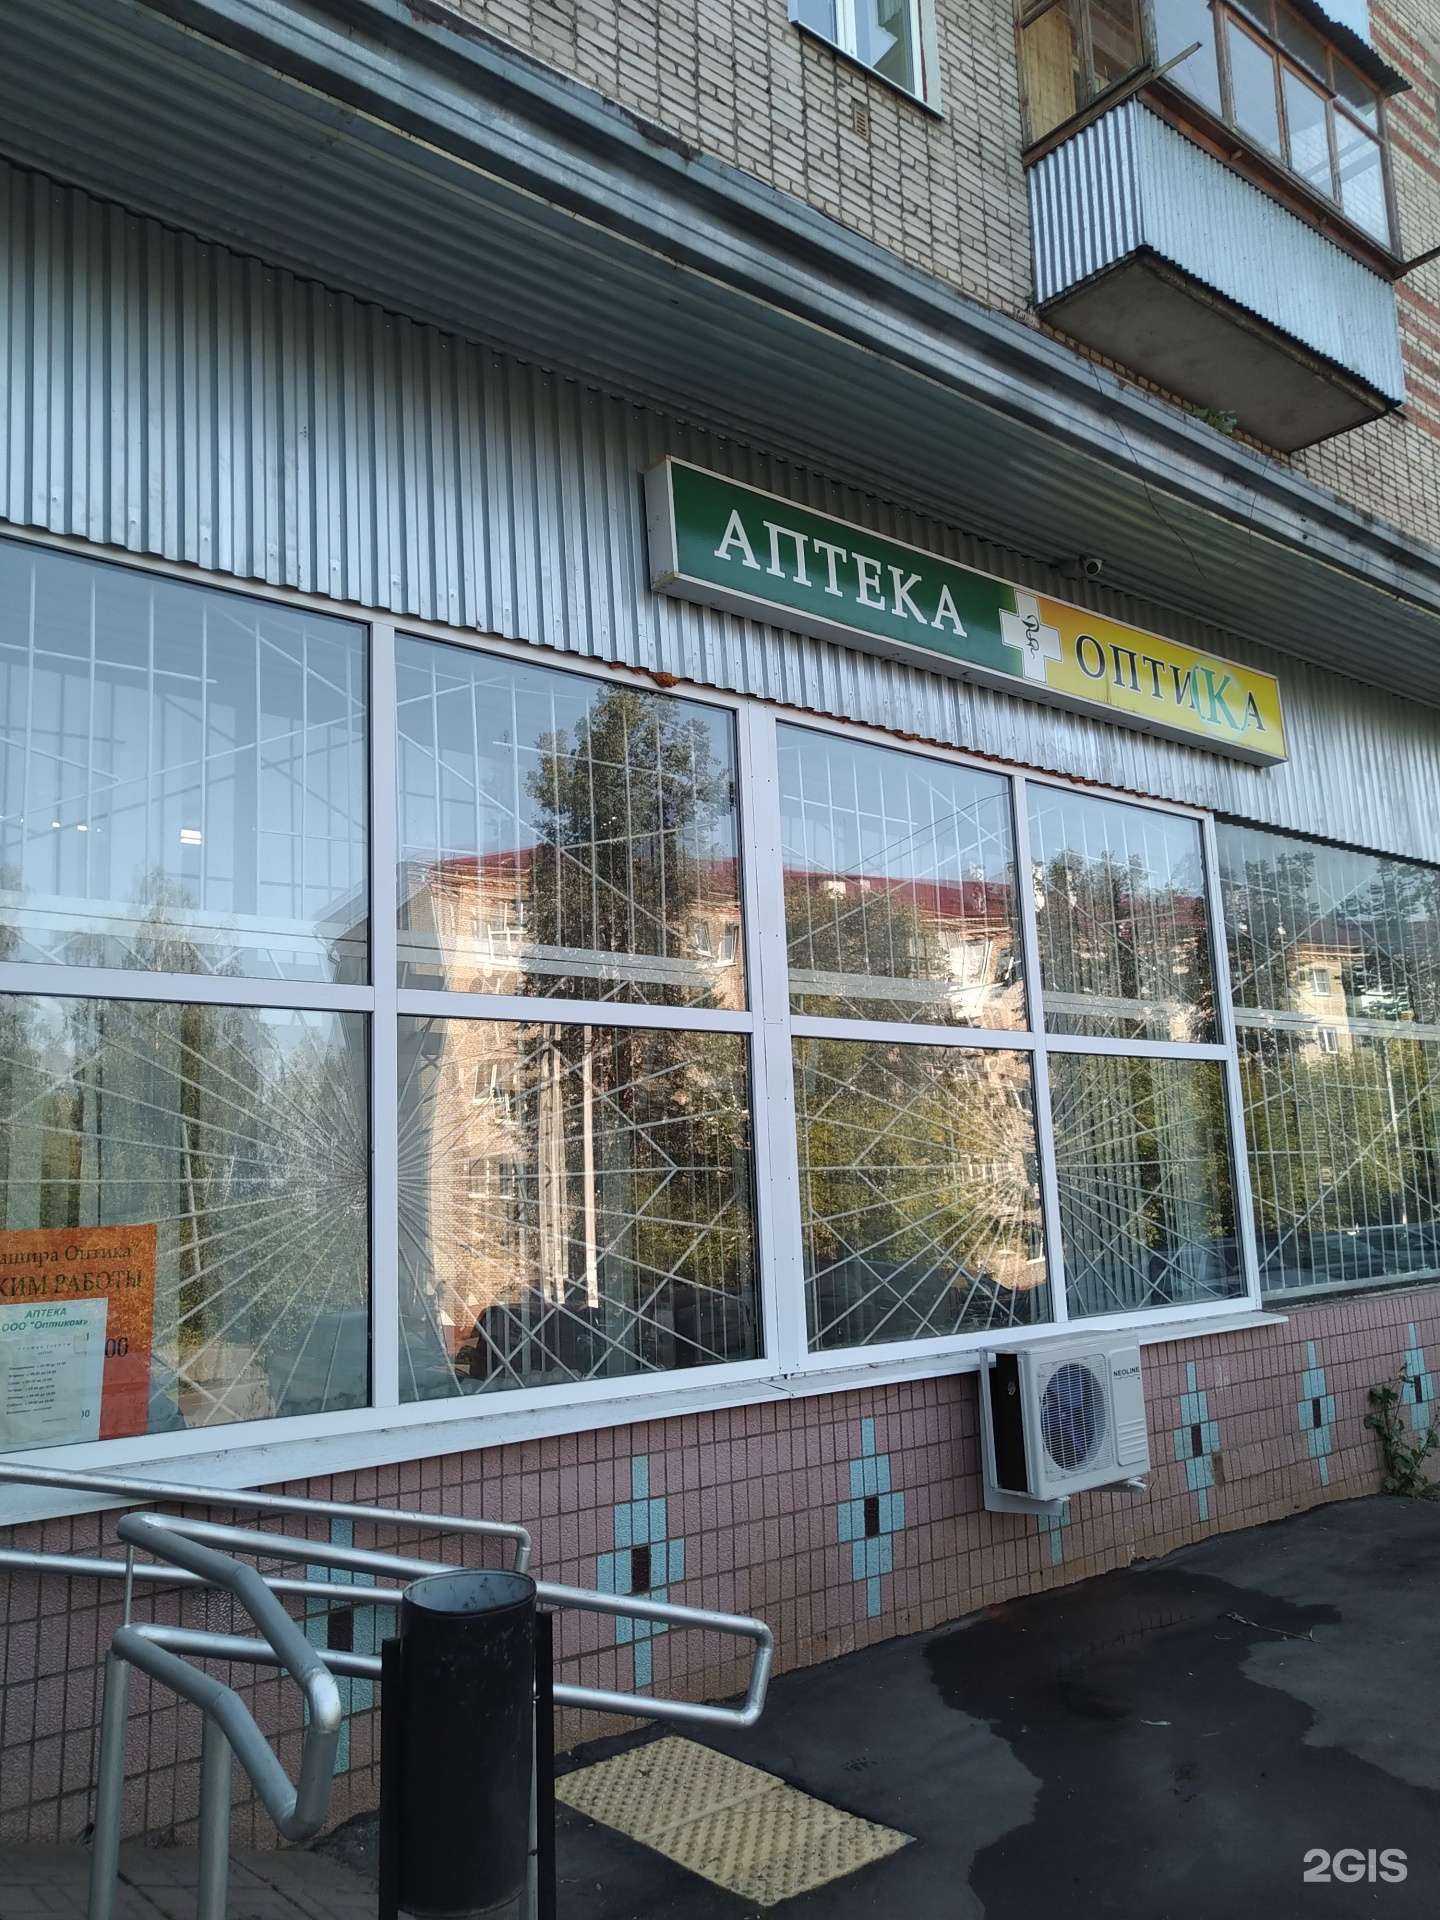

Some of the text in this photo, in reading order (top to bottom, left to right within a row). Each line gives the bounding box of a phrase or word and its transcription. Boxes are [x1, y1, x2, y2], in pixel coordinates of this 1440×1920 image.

[714, 509, 967, 638] АПТЕКА
[54, 1270, 141, 1294] РАБОТЫ
[25, 1307, 66, 1319] АПТЕКА
[2, 1322, 26, 1332] ООО
